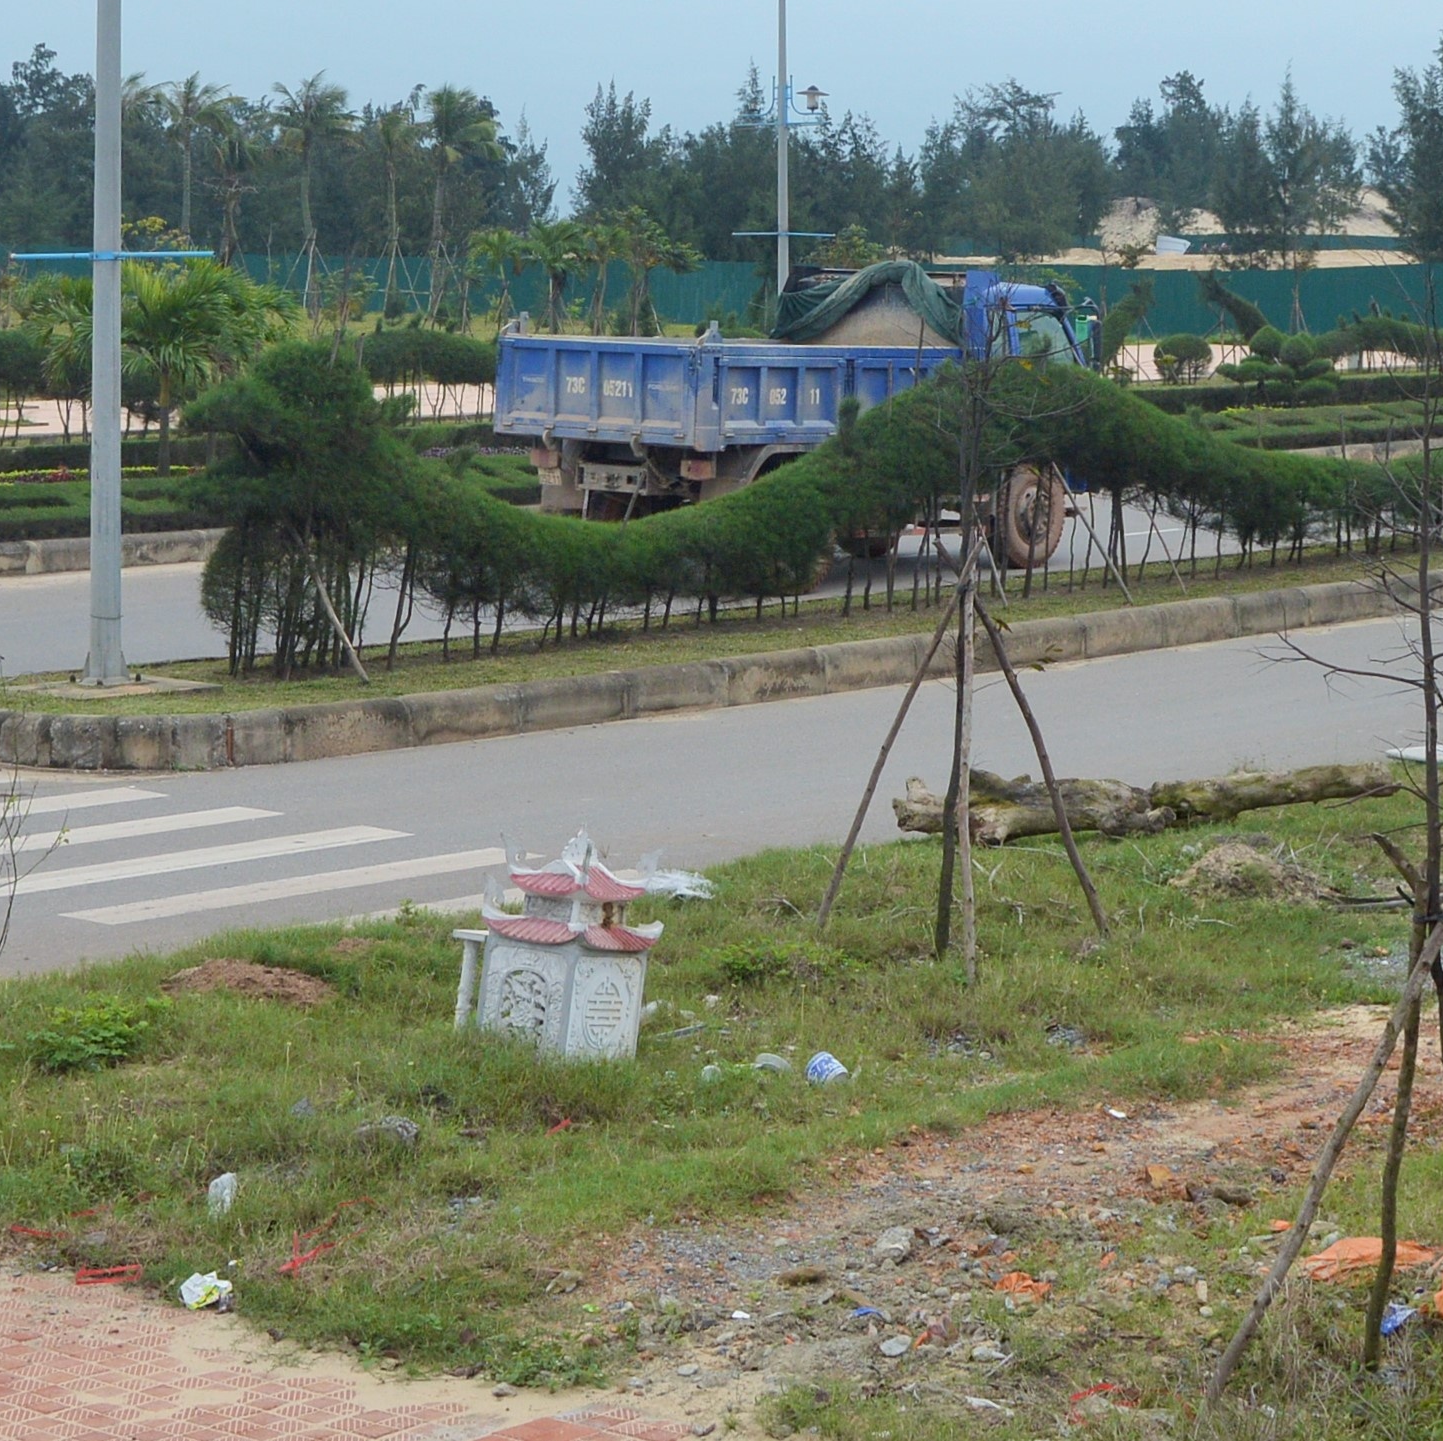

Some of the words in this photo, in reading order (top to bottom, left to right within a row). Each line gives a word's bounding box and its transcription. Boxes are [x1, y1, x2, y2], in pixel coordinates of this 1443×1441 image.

[566, 376, 586, 394] 73C
[603, 380, 633, 398] 05211
[731, 387, 749, 405] 73C
[769, 388, 787, 405] 052
[810, 388, 820, 405] 11
